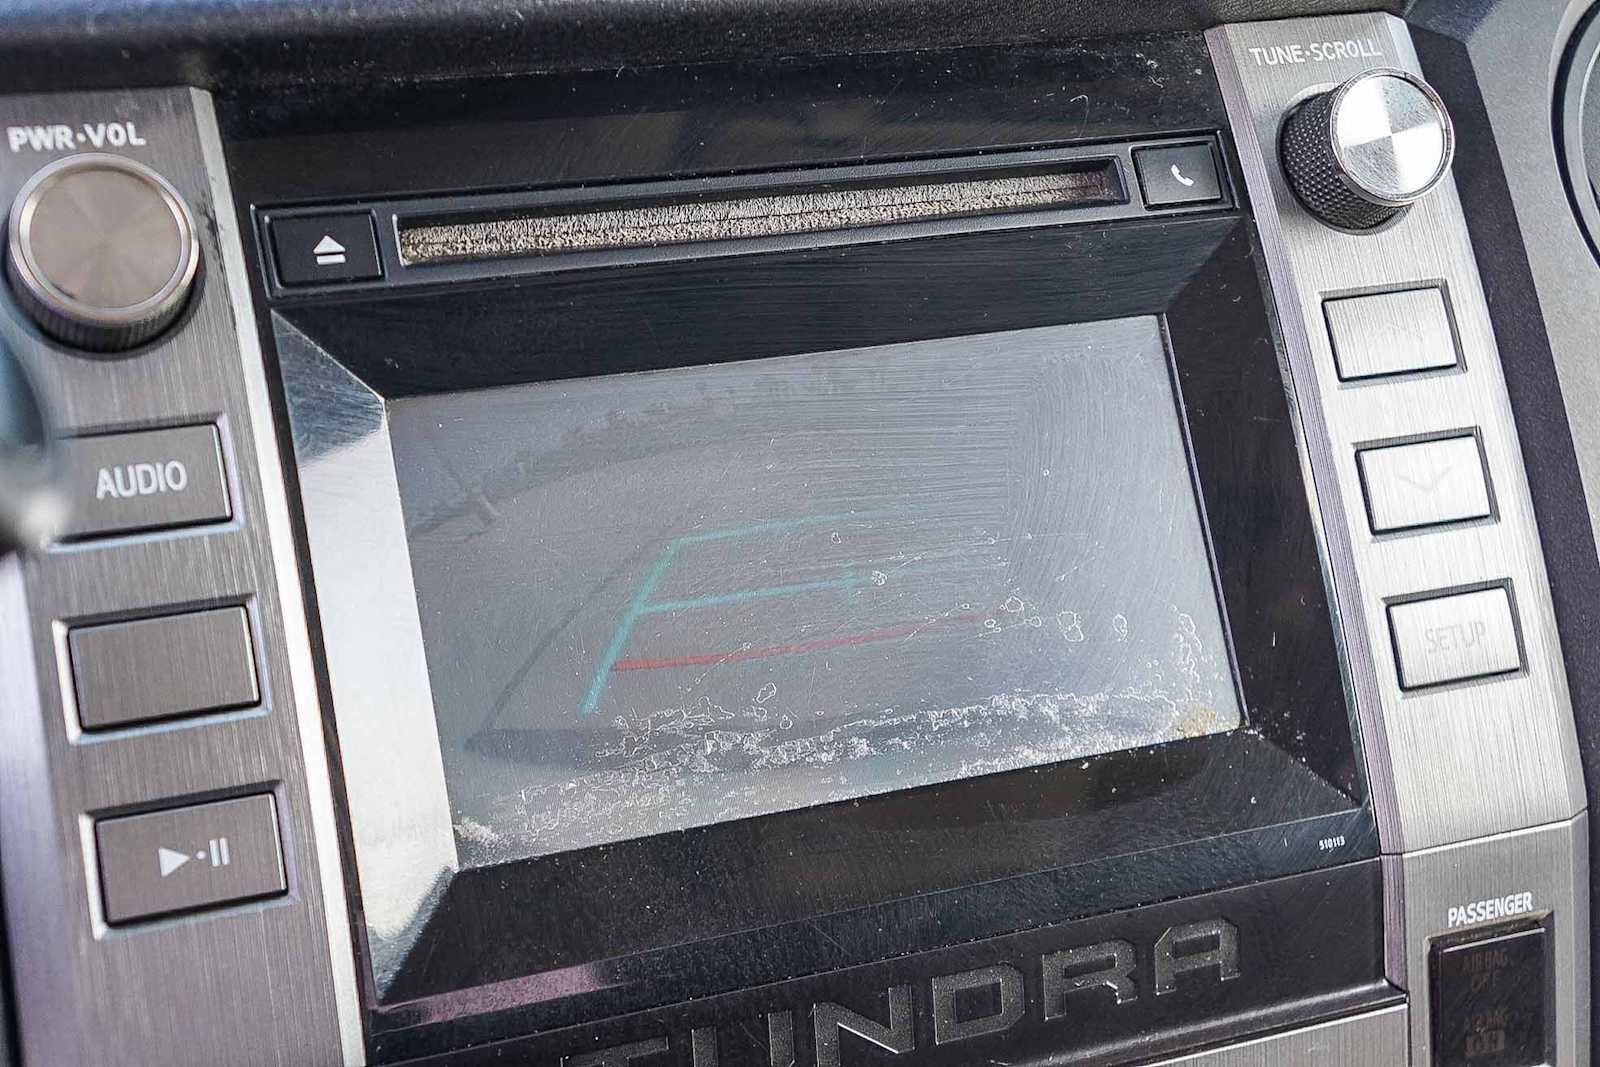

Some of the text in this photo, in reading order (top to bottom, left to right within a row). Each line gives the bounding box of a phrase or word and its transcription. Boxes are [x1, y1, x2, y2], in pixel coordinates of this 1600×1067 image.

[96, 460, 188, 500] AUDIO
[1424, 621, 1486, 653] SETUP
[1447, 891, 1533, 928] PASSENGER
